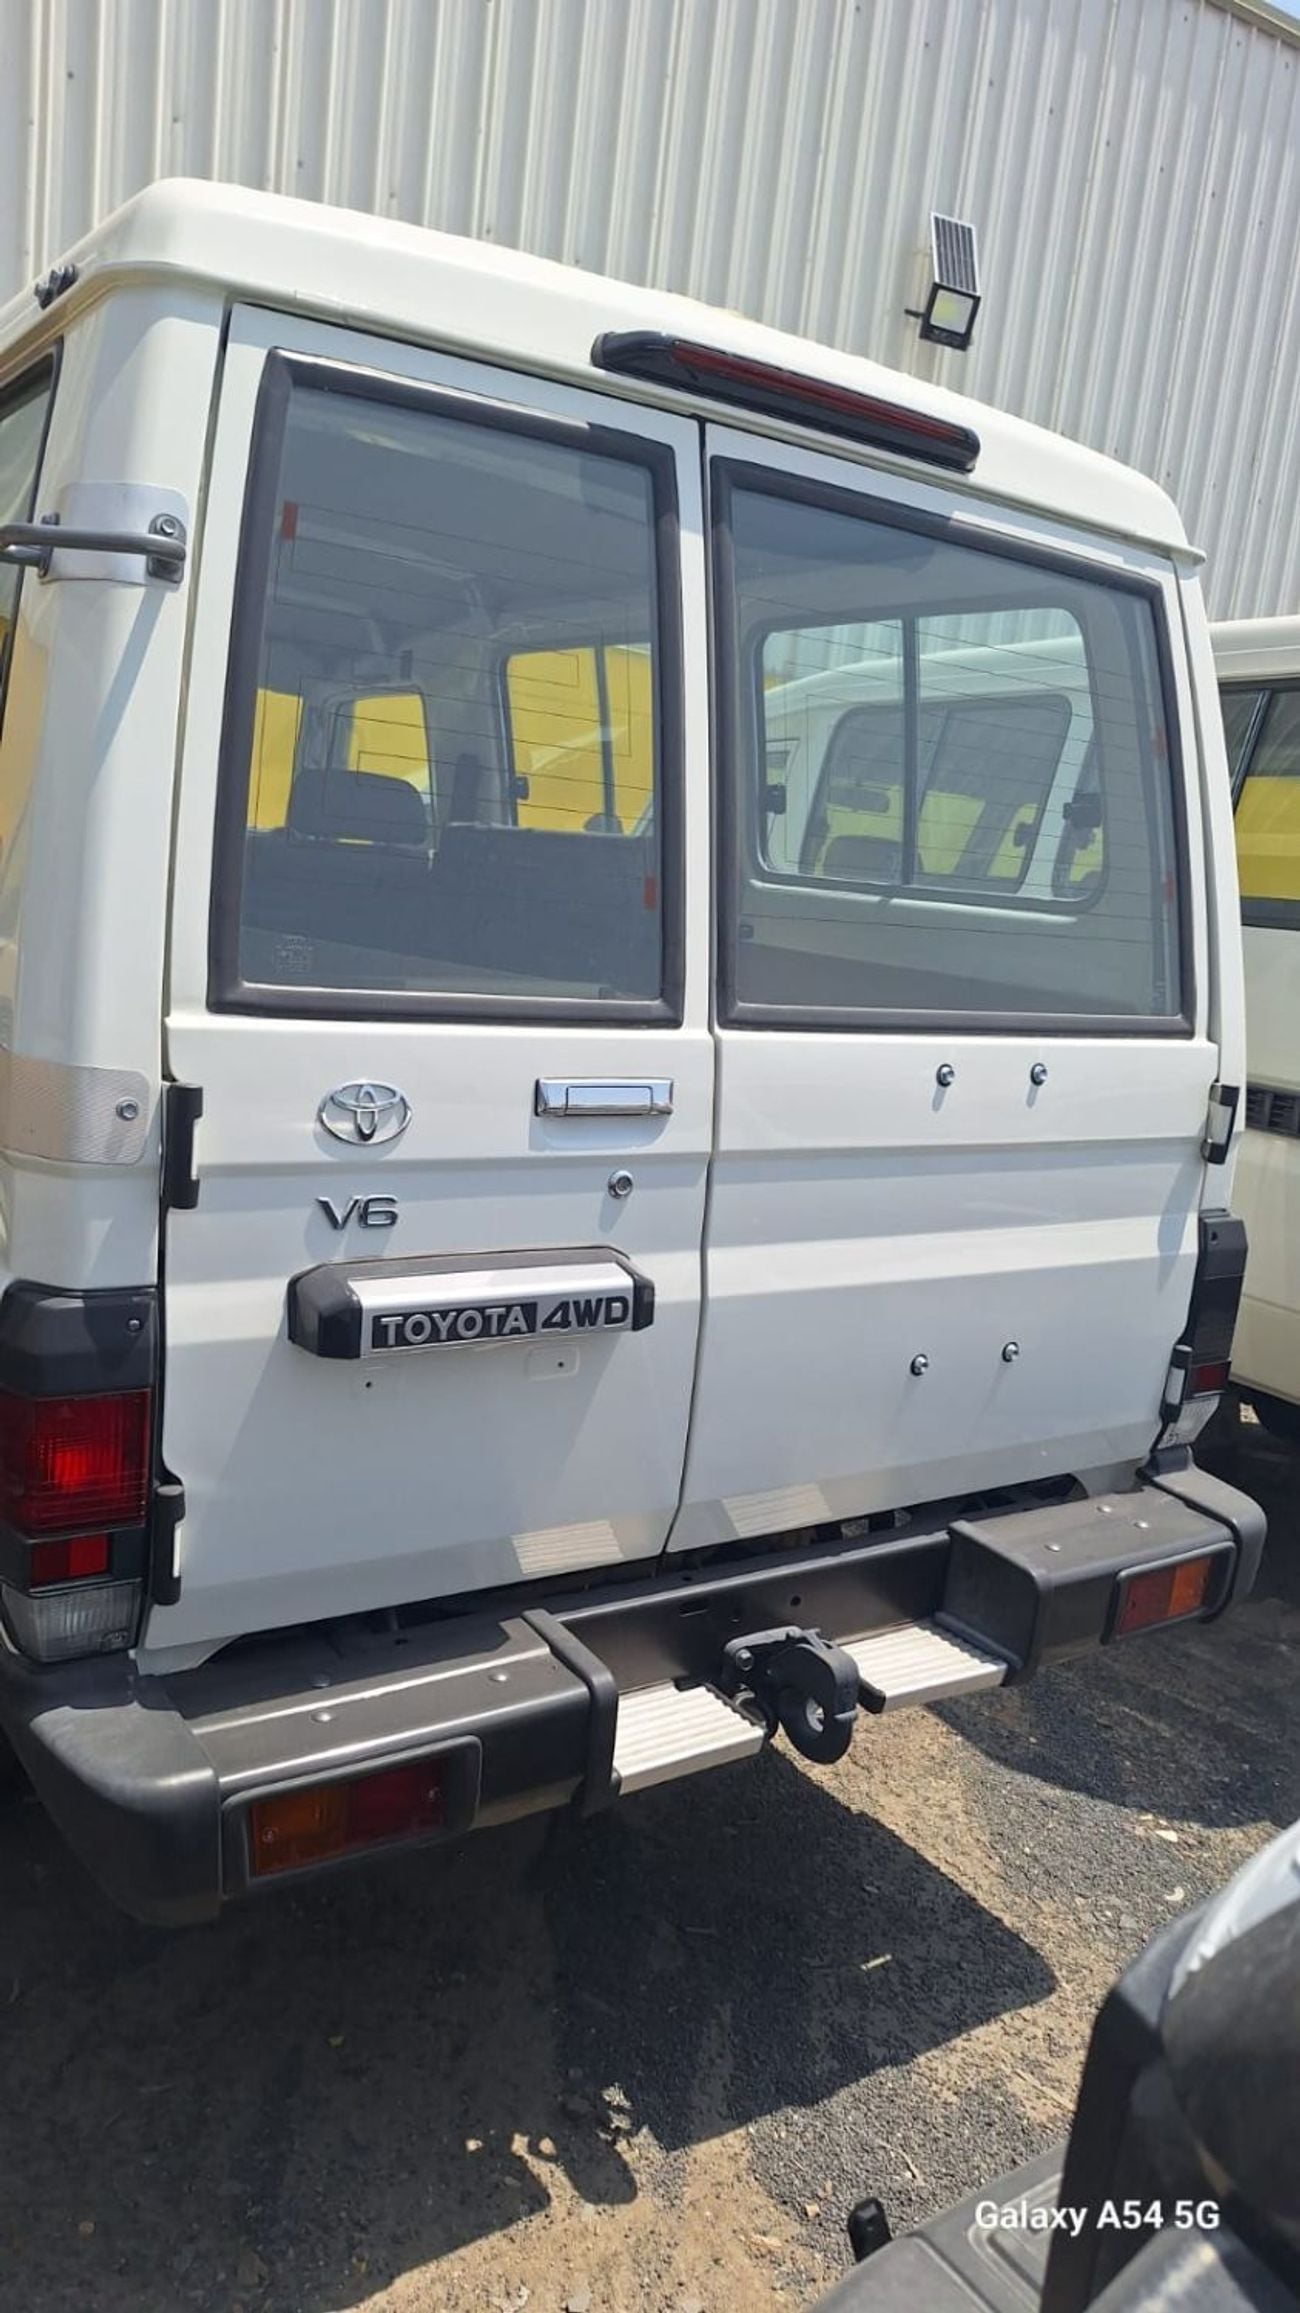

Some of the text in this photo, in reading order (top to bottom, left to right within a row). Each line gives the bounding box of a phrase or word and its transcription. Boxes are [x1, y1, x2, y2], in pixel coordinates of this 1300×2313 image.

[316, 1194, 399, 1230] V6
[379, 1295, 630, 1347] TOYOTA 4WD
